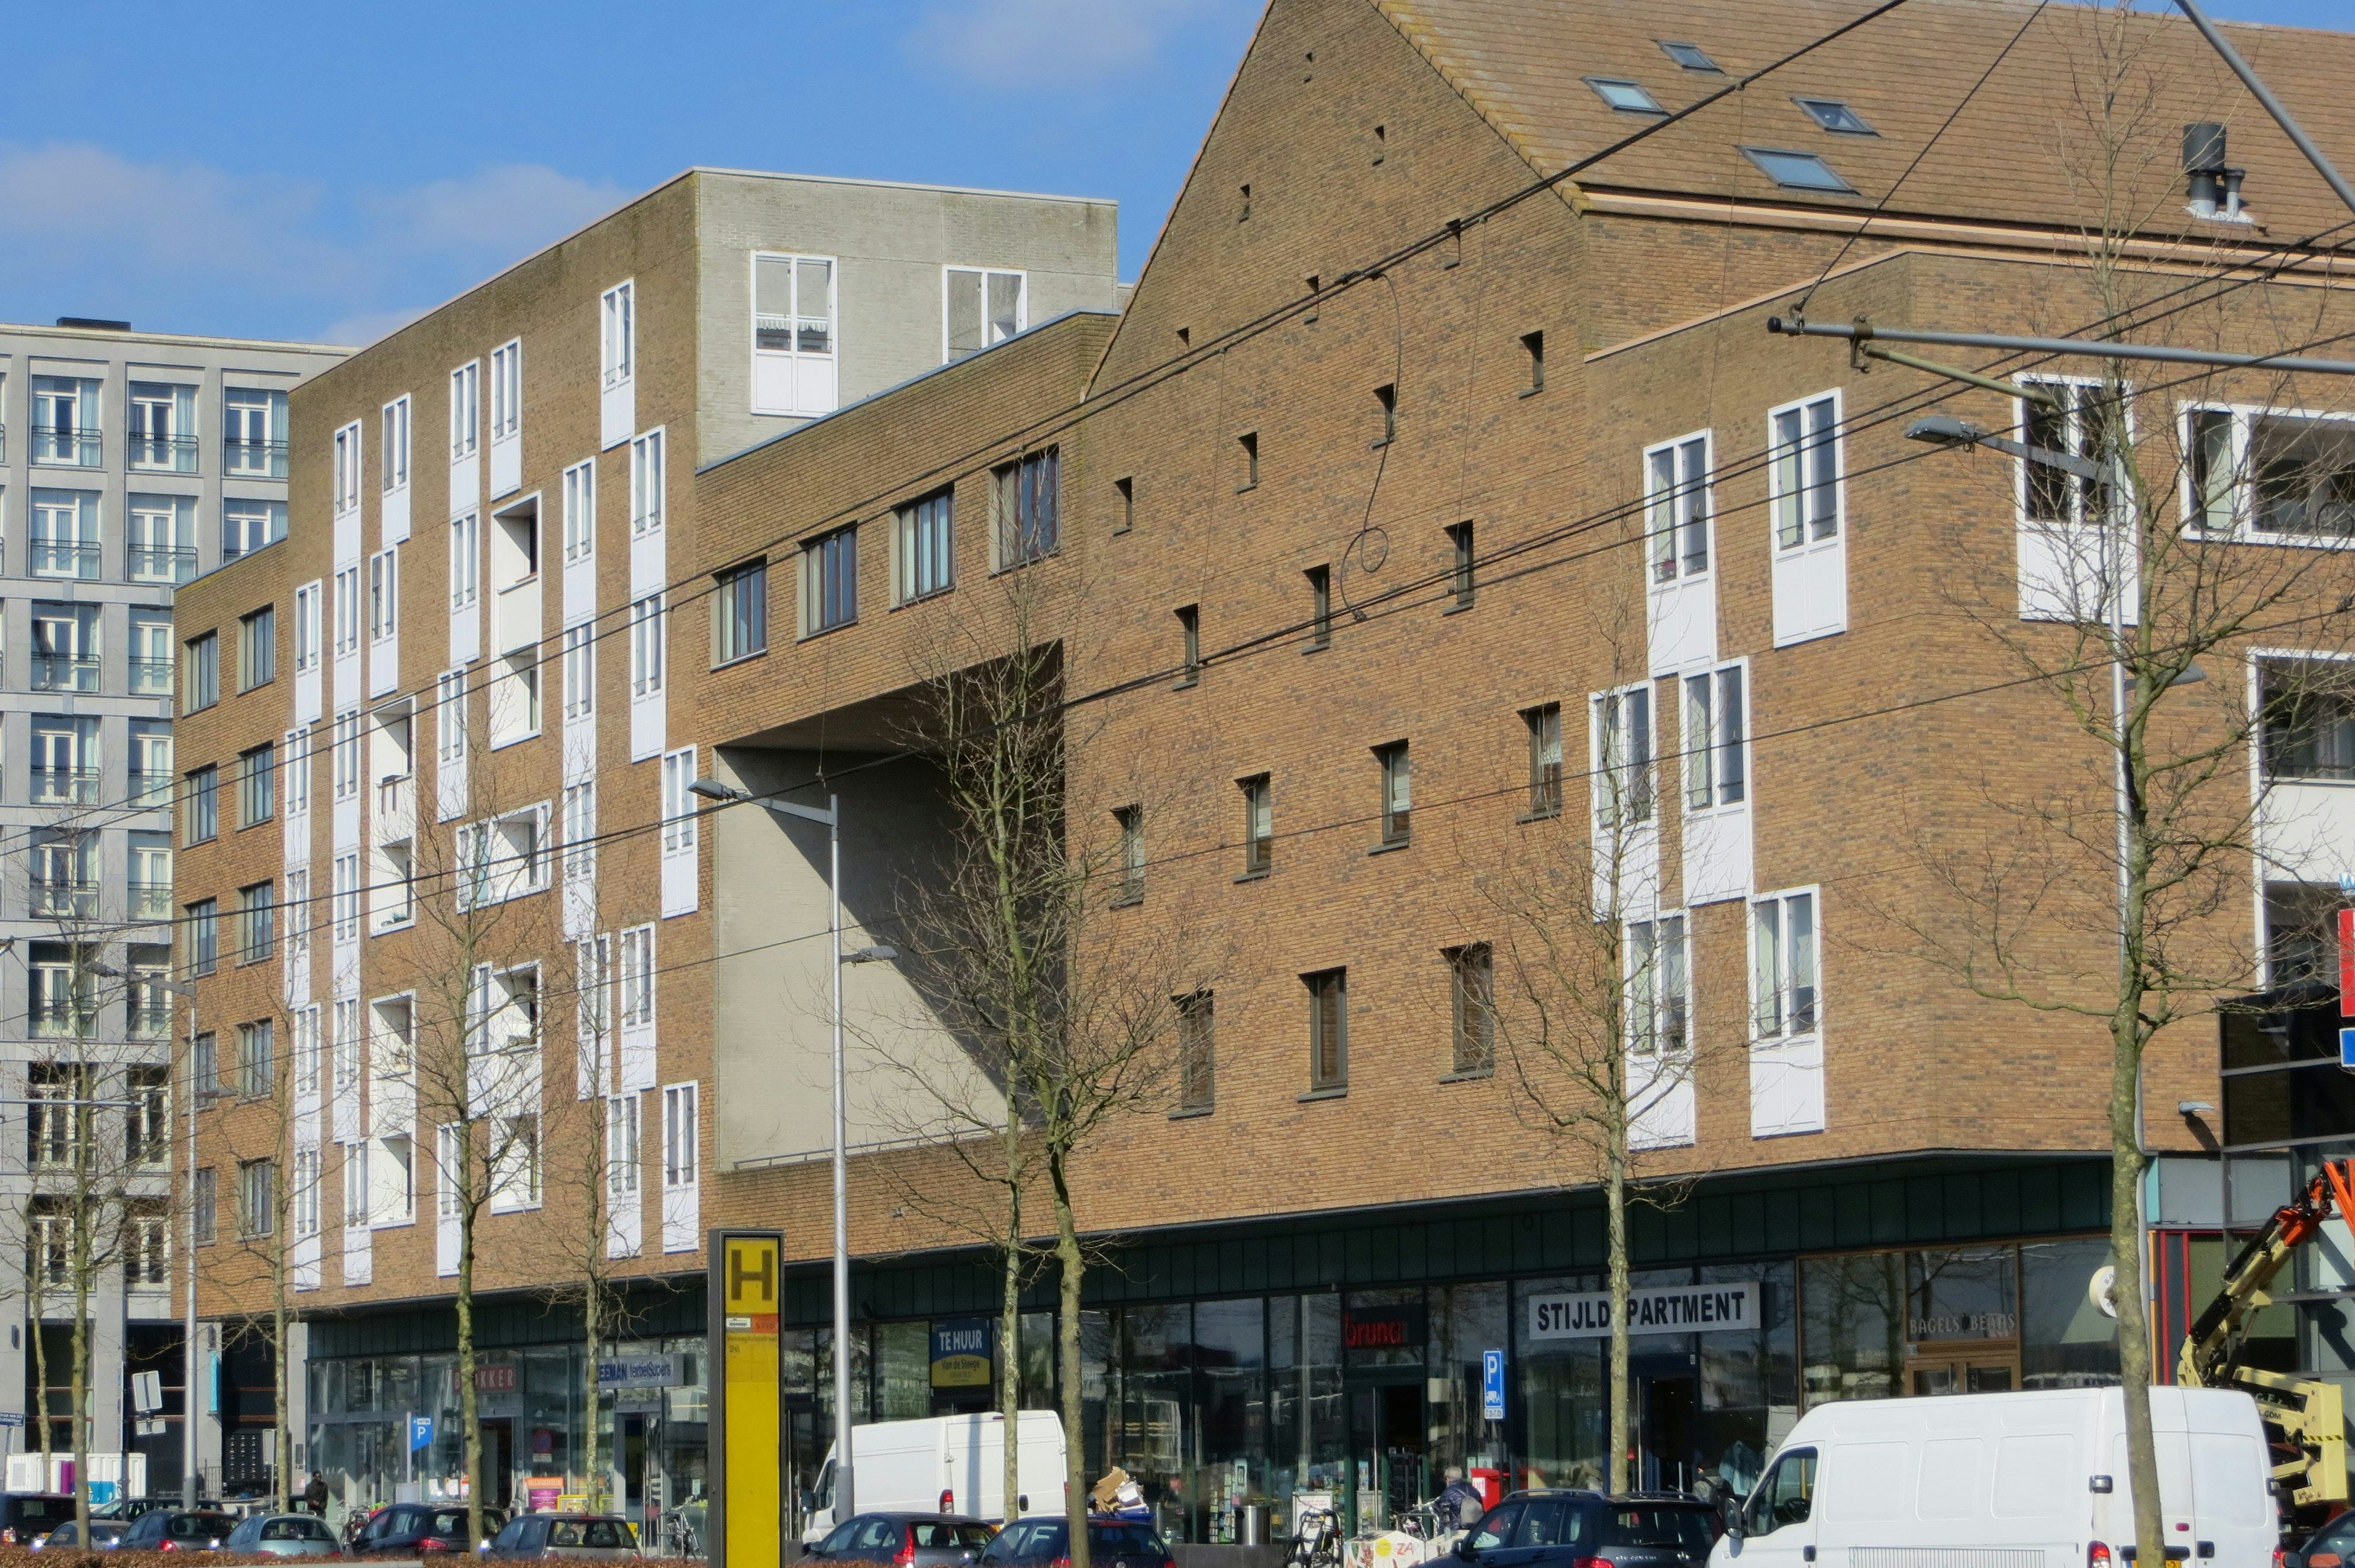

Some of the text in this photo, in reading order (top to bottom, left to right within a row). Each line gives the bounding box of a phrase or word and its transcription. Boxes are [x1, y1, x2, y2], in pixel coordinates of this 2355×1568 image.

[731, 1250, 772, 1301] H
[1538, 1291, 1745, 1332] STIJLDPARTMENT
[1344, 1311, 1402, 1346] bruna
[1909, 1317, 1961, 1334] BAGELS
[938, 1329, 983, 1351] TE HUUR
[454, 1367, 513, 1390] BKKER
[598, 1363, 628, 1382] EEMAN
[1488, 1355, 1498, 1384] P
[417, 1426, 426, 1440] P
